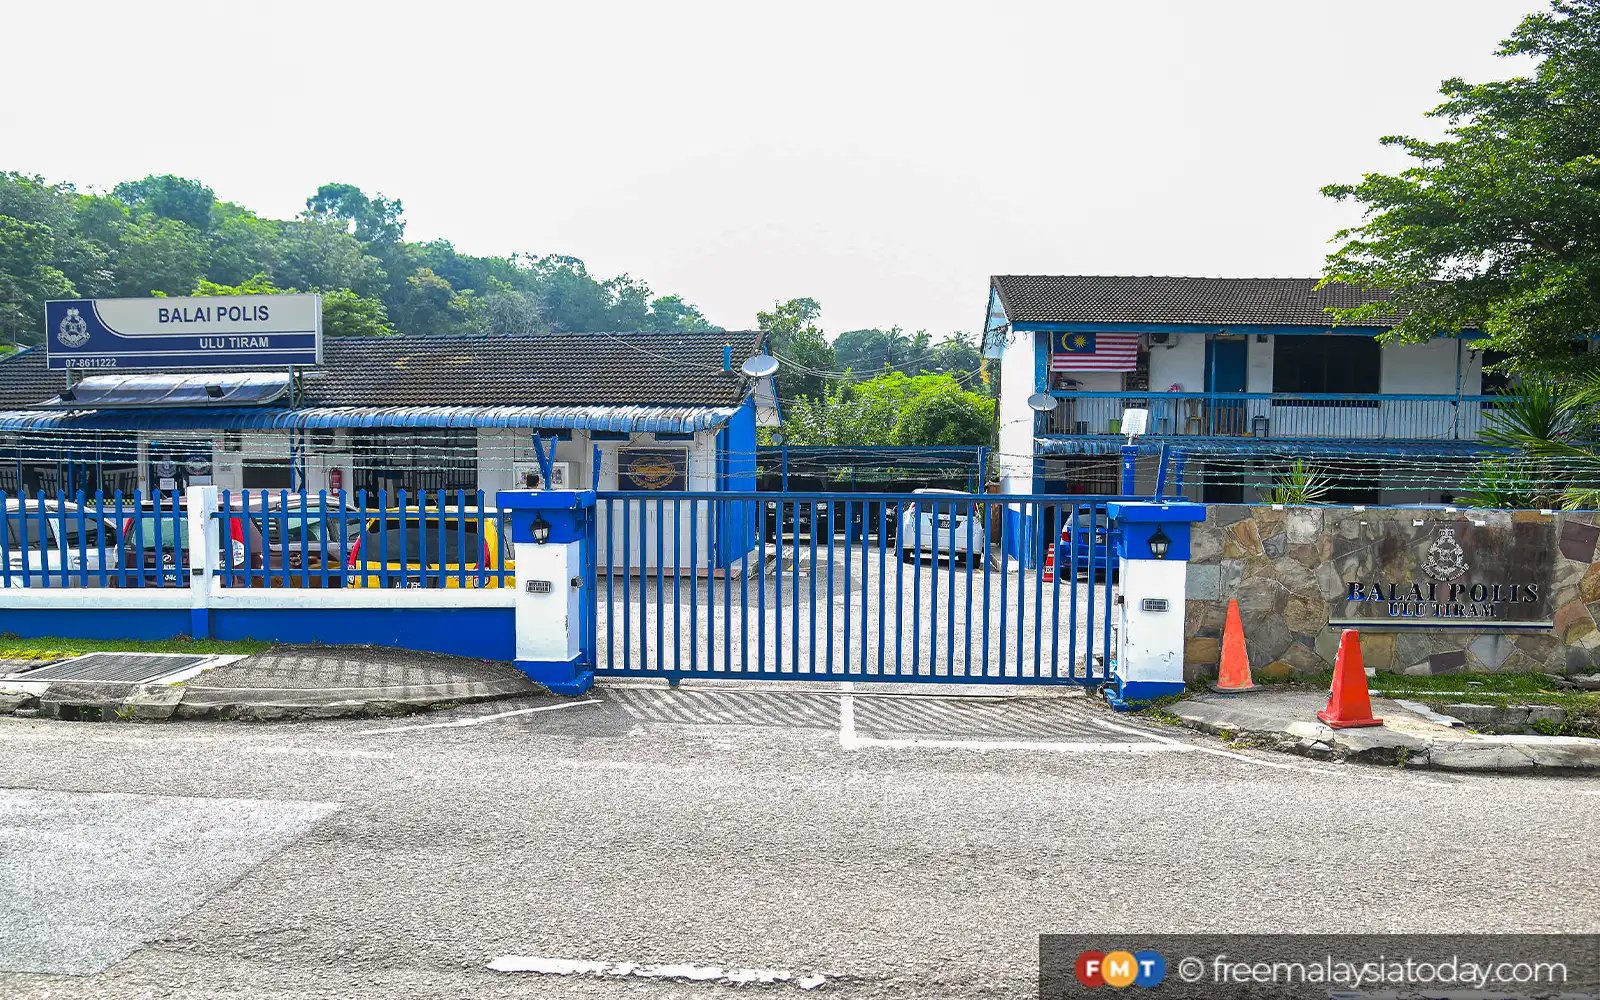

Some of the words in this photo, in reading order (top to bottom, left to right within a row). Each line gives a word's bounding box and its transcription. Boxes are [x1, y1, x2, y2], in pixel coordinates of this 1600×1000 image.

[158, 306, 211, 323] BALAI
[217, 305, 269, 322] POLIS
[199, 337, 225, 349] ULU
[228, 336, 269, 348] TIRAM
[65, 358, 117, 368] 07-8611222
[1346, 582, 1437, 603] BALAI
[1448, 582, 1539, 604] POLIS
[1388, 602, 1427, 617] ULU
[1431, 602, 1497, 618] TIRAM
